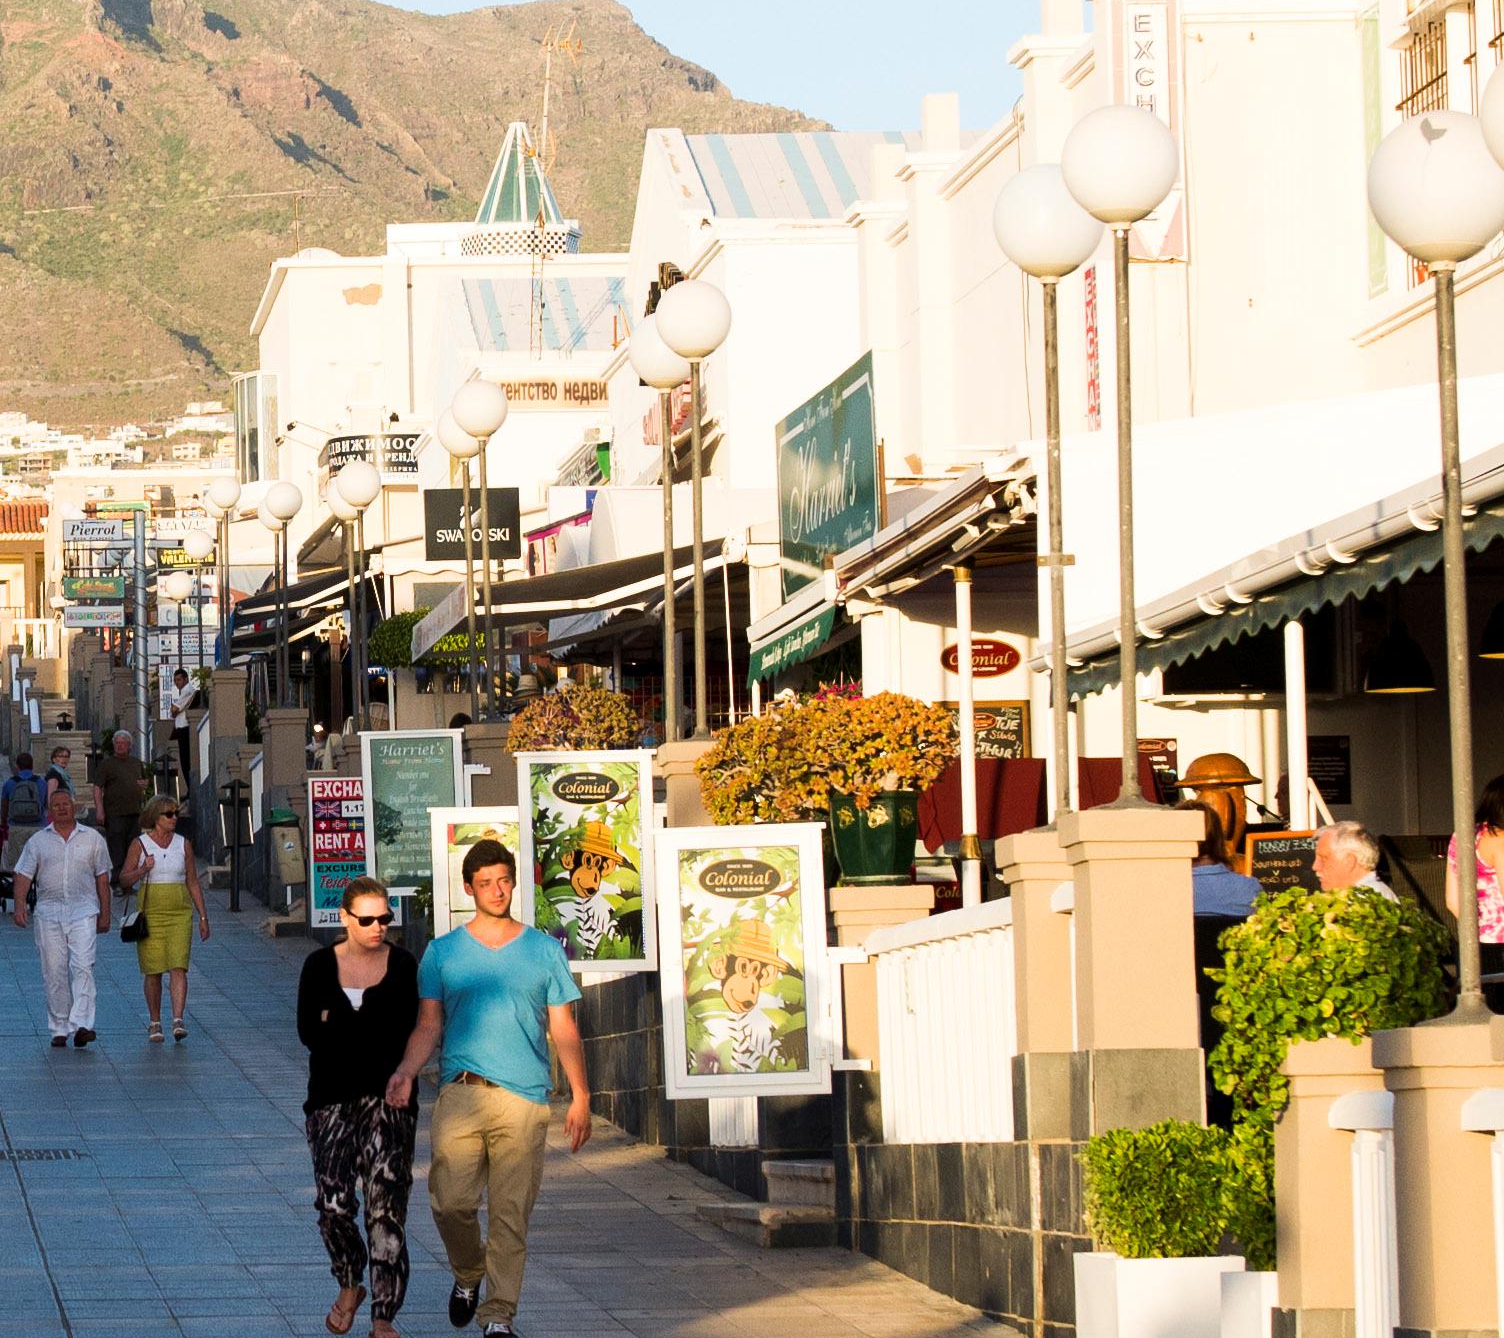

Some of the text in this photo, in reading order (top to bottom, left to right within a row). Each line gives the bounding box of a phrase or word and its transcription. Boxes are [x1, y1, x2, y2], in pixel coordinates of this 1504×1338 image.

[501, 380, 558, 400] гентство
[71, 524, 116, 536] Pierrot
[436, 528, 510, 543] SWAOSKI
[949, 651, 1013, 666] Conial
[379, 742, 445, 757] Harriet's
[313, 781, 363, 798] EXCHA
[558, 781, 613, 794] Colonial
[315, 833, 364, 850] RENT A
[317, 865, 366, 873] EXCURS
[705, 870, 773, 886] Colonial
